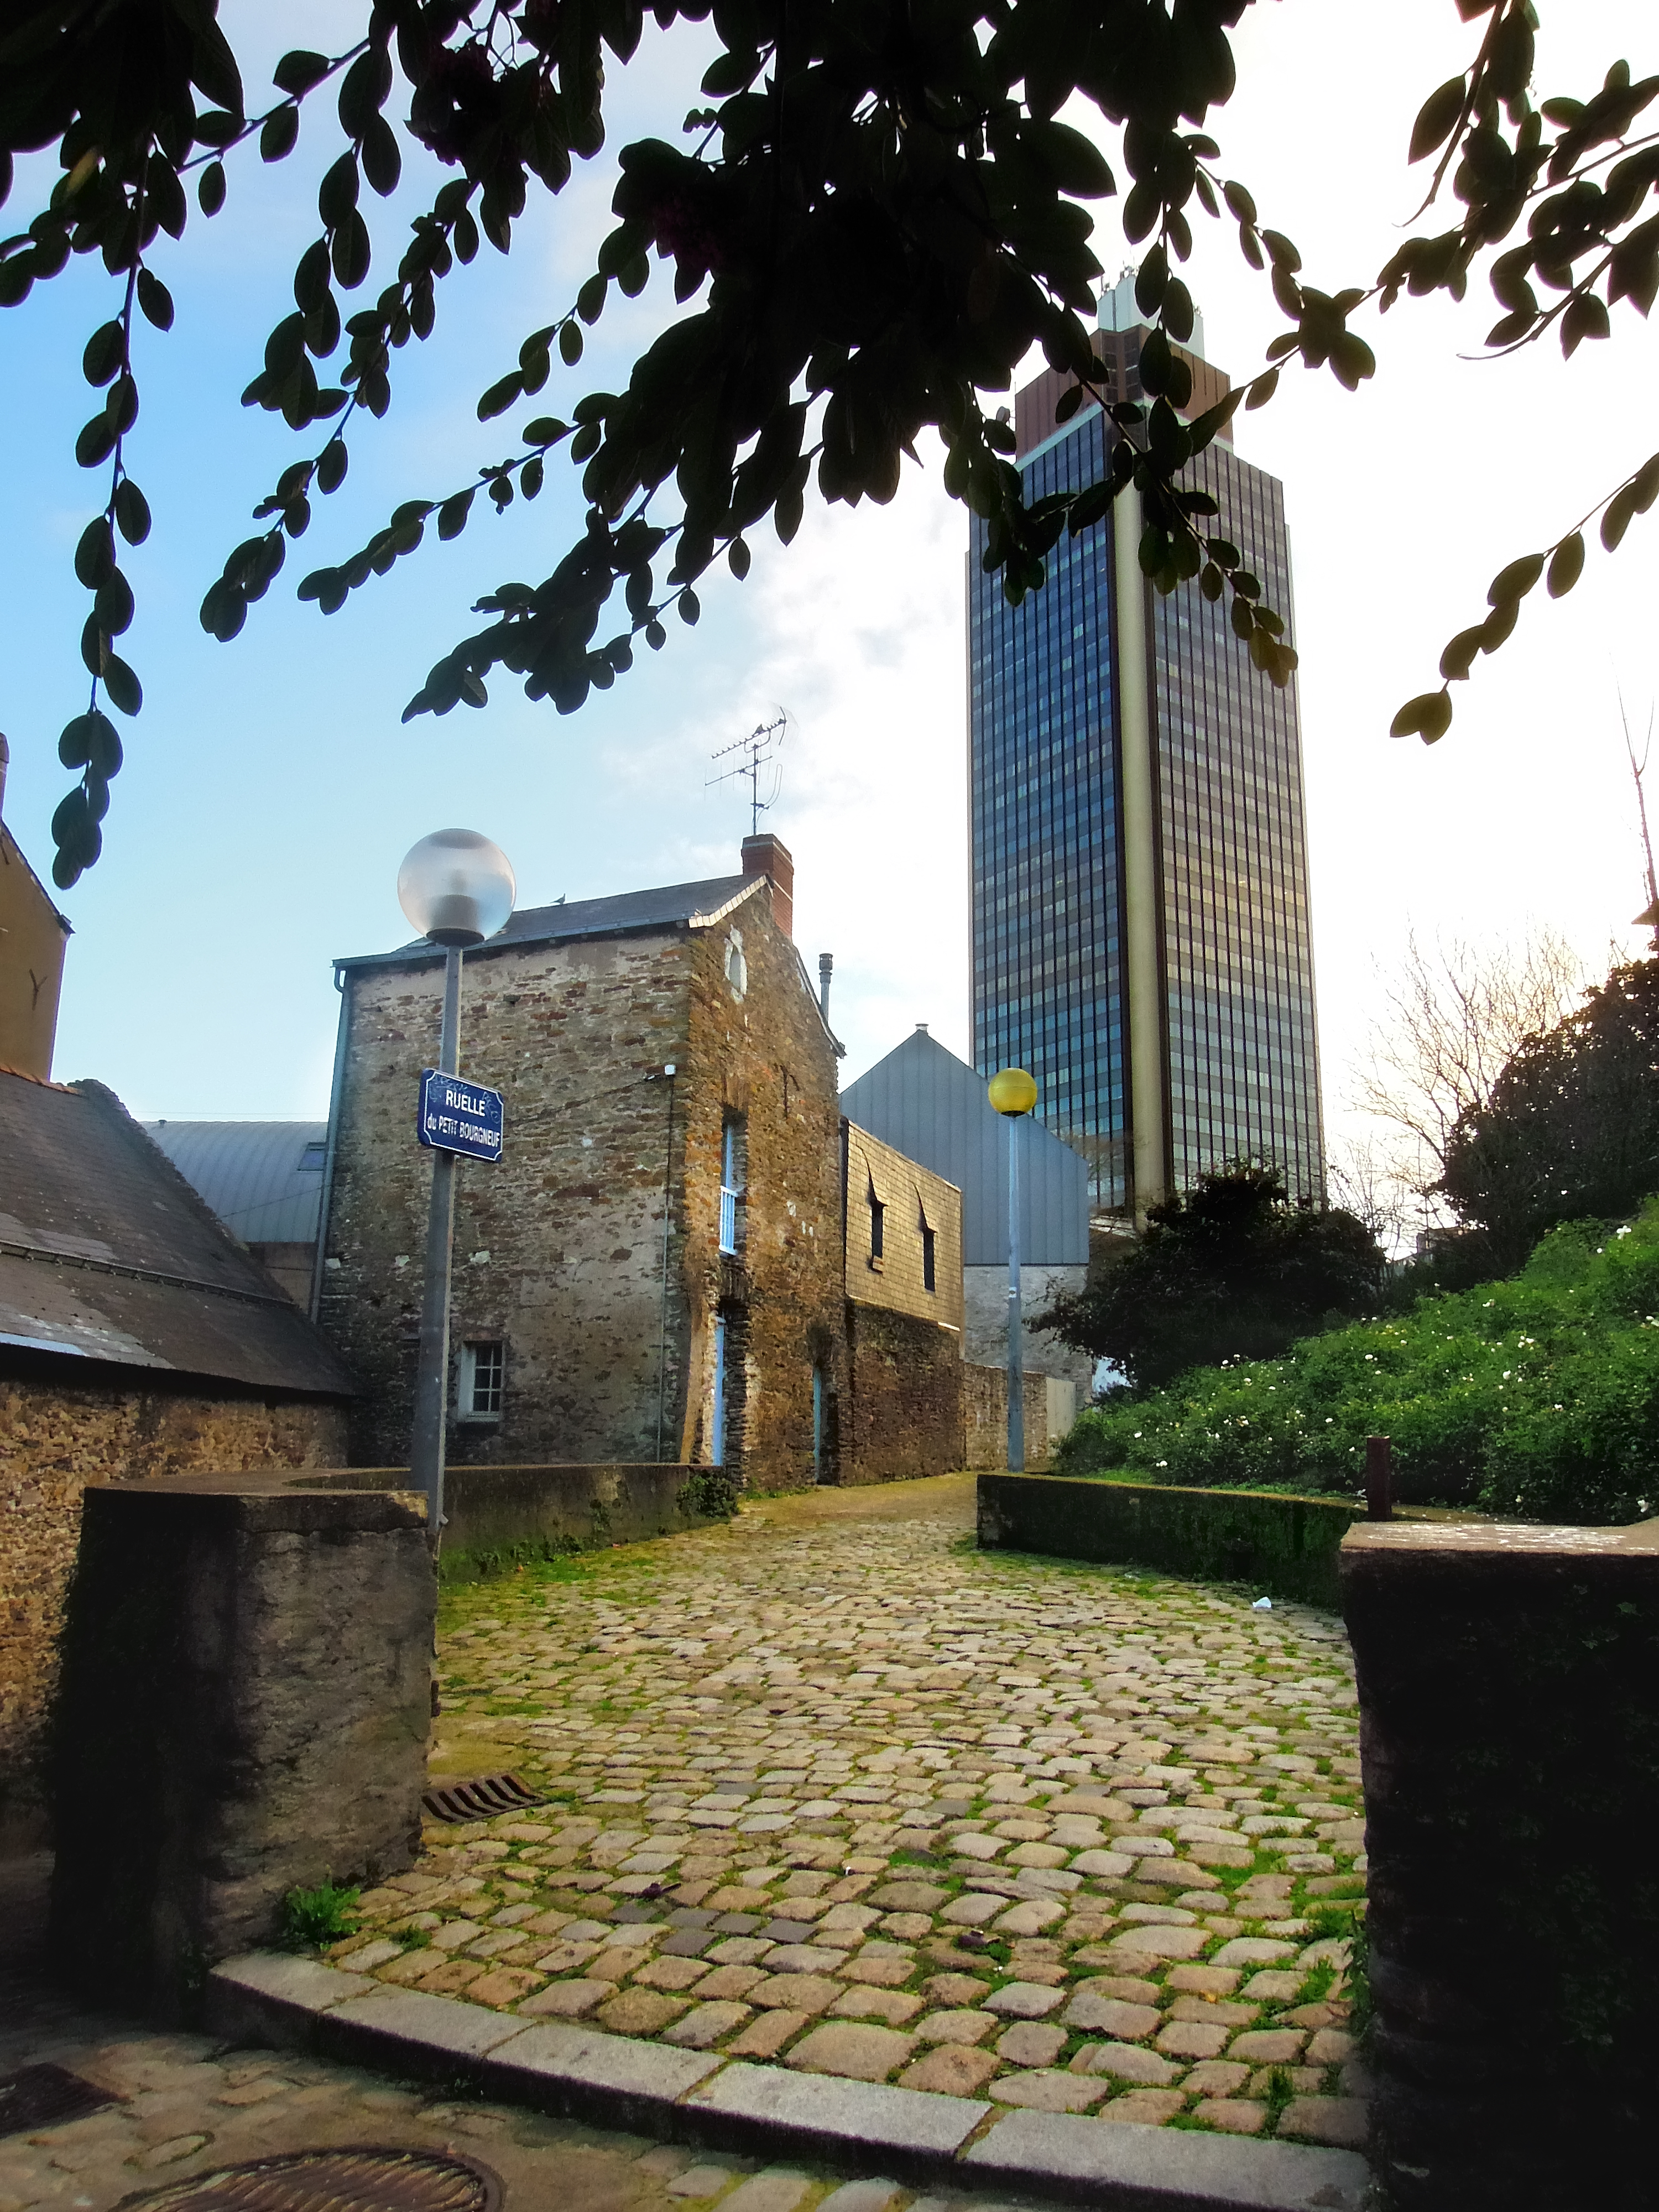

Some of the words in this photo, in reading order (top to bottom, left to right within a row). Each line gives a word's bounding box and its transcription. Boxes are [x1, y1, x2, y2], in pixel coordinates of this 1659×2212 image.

[446, 1089, 486, 1117] RUELLE
[427, 1113, 437, 1130] du
[439, 1115, 458, 1135] PETIT
[460, 1121, 500, 1147] BOURGNEUF
